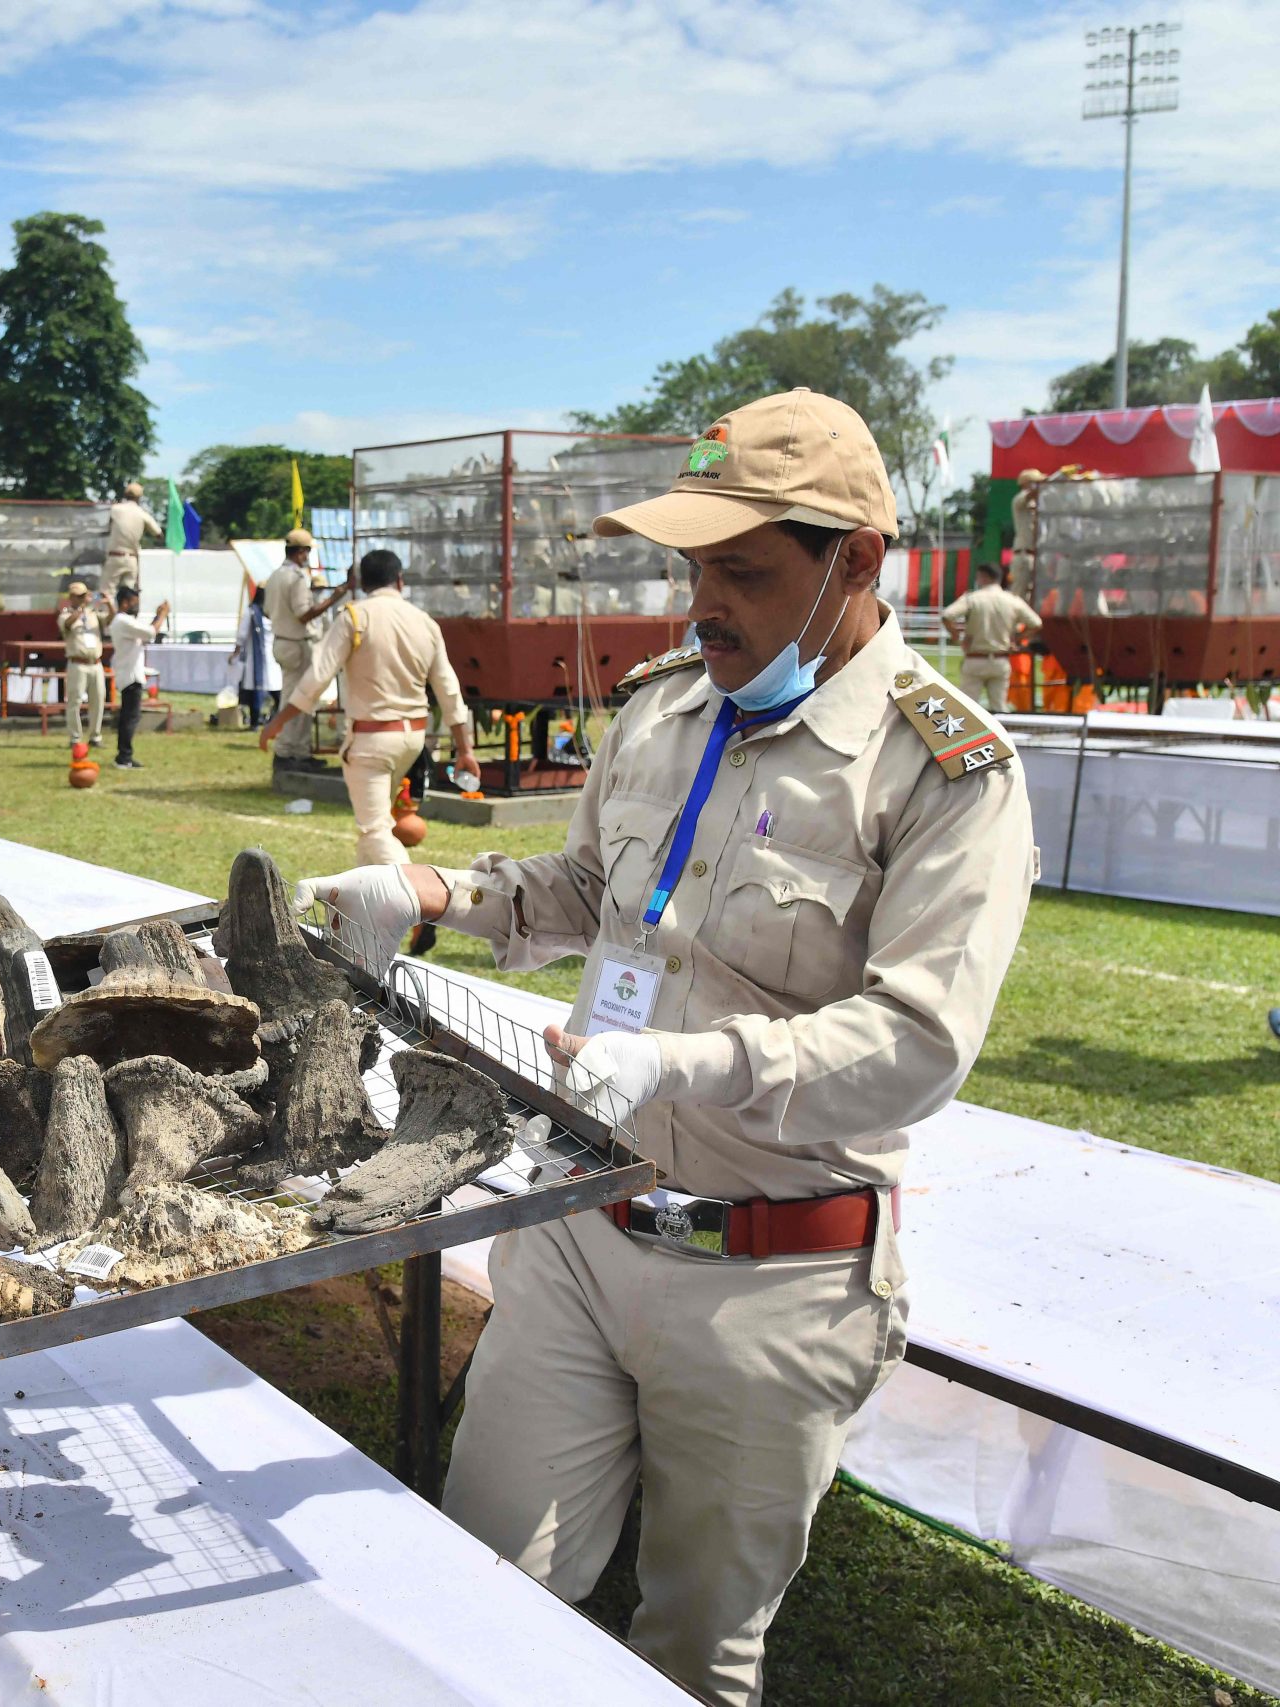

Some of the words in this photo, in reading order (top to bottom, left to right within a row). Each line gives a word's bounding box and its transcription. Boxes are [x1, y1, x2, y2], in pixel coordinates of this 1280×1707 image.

[700, 471, 721, 480] PARK
[600, 999, 628, 1015] PROXIMITY
[627, 1008, 642, 1020] PASS
